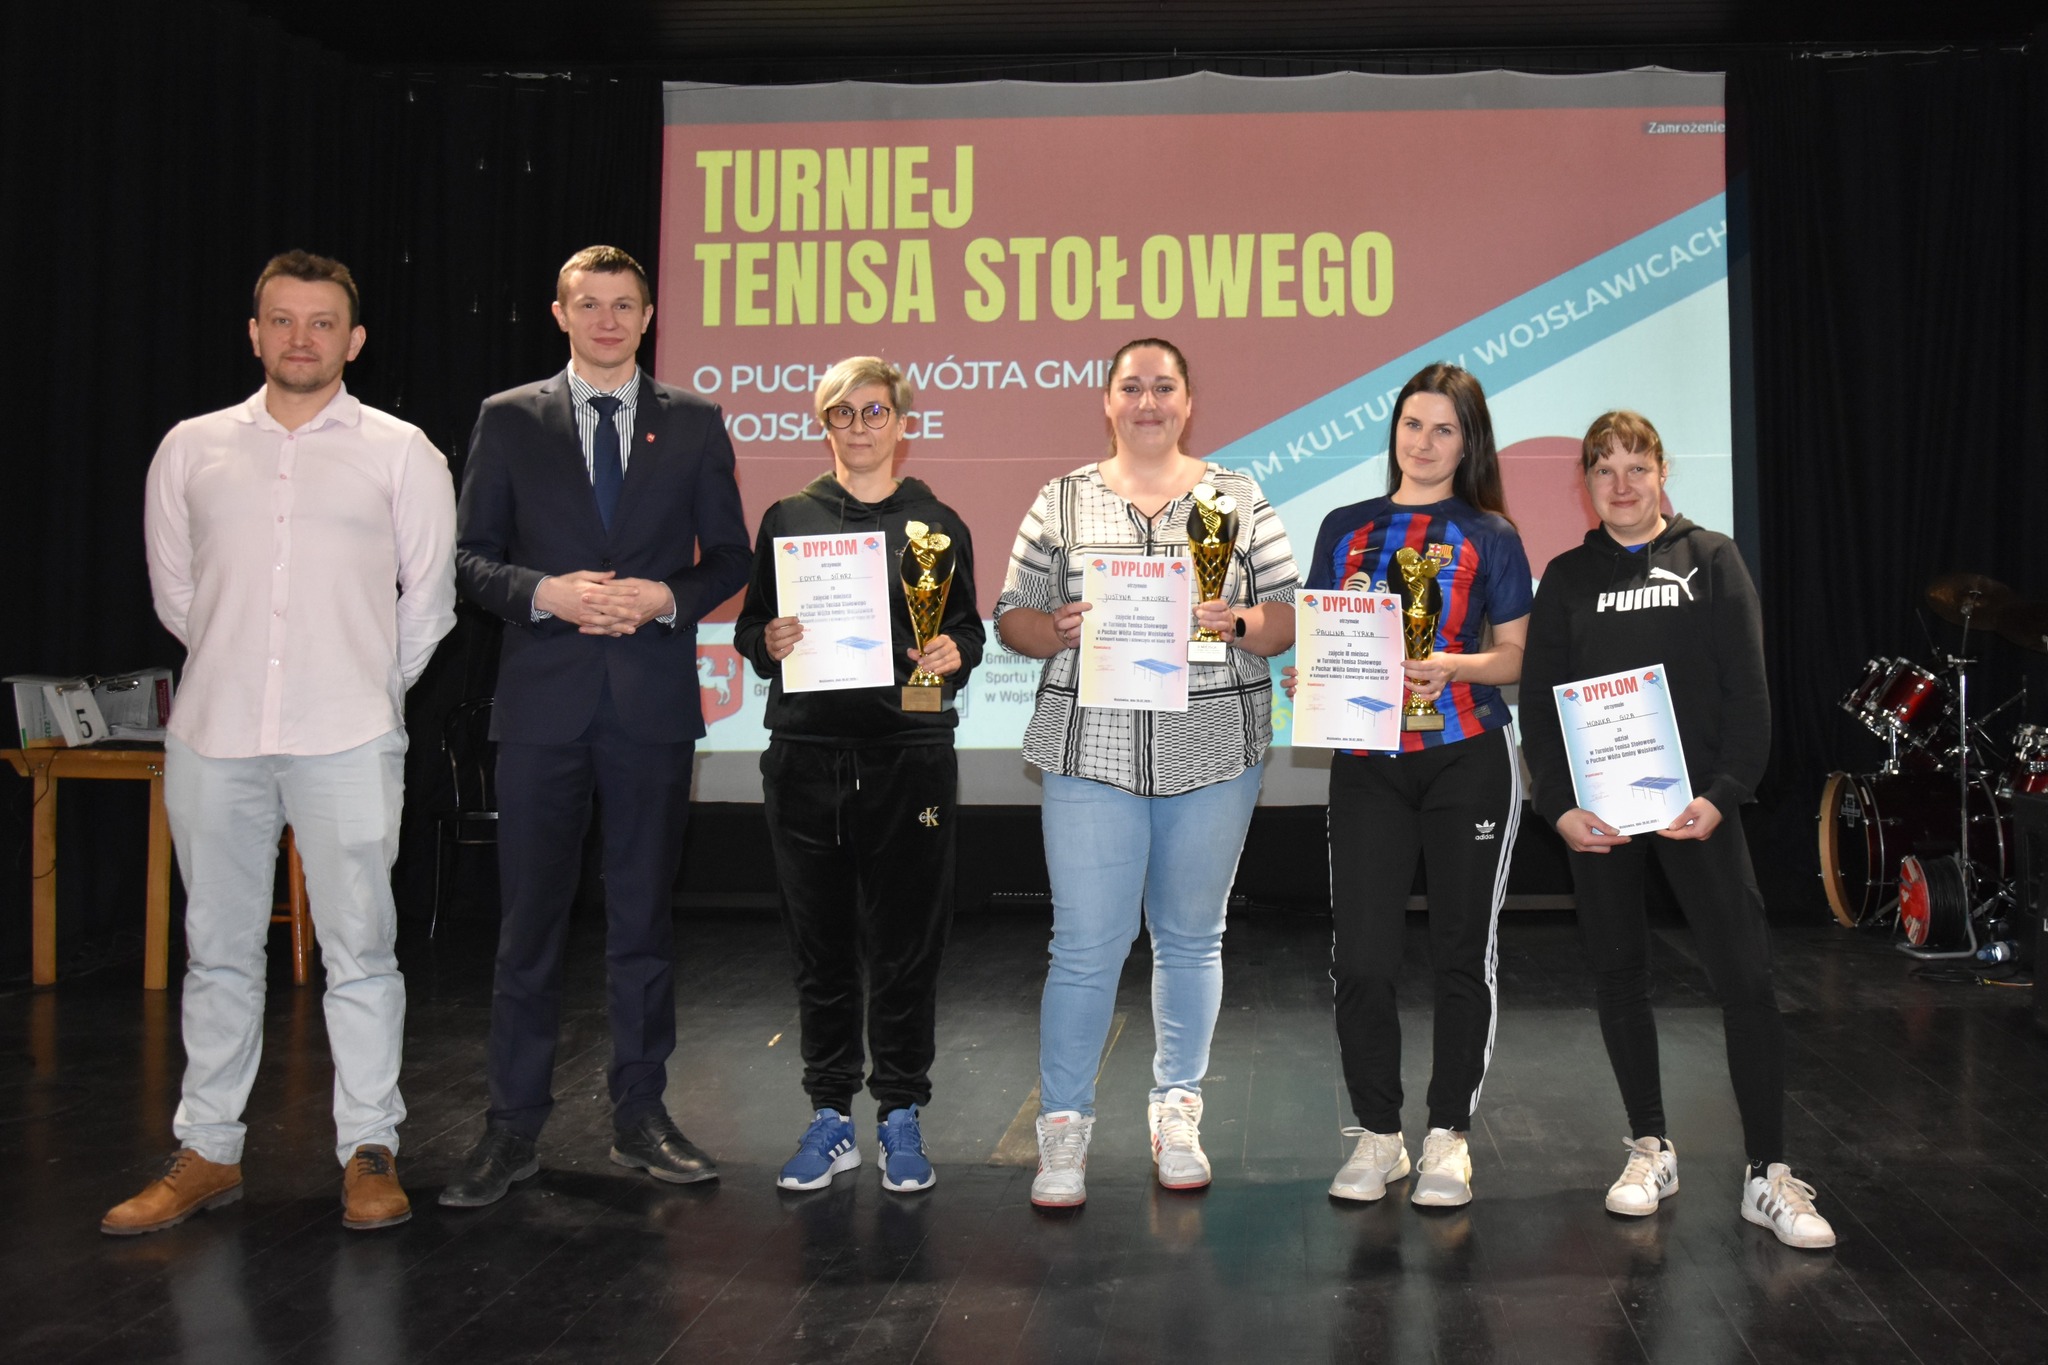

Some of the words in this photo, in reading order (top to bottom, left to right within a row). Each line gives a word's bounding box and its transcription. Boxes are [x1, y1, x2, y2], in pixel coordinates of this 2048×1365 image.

[1648, 121, 1726, 134] Zamrożenie
[697, 145, 974, 232] TURNIEJ
[695, 240, 936, 326] TENISA
[963, 231, 1394, 322] STOŁOWEGO
[693, 366, 722, 394] O
[803, 539, 858, 557] DYPLOM
[1111, 560, 1164, 578] DYPLOM
[1323, 596, 1375, 613] DYPLOM
[1597, 584, 1679, 612] PUMA
[1315, 628, 1345, 636] PAULINA
[985, 671, 1027, 685] Sportu
[1582, 676, 1639, 702] DYPLOM
[76, 709, 93, 738] 5
